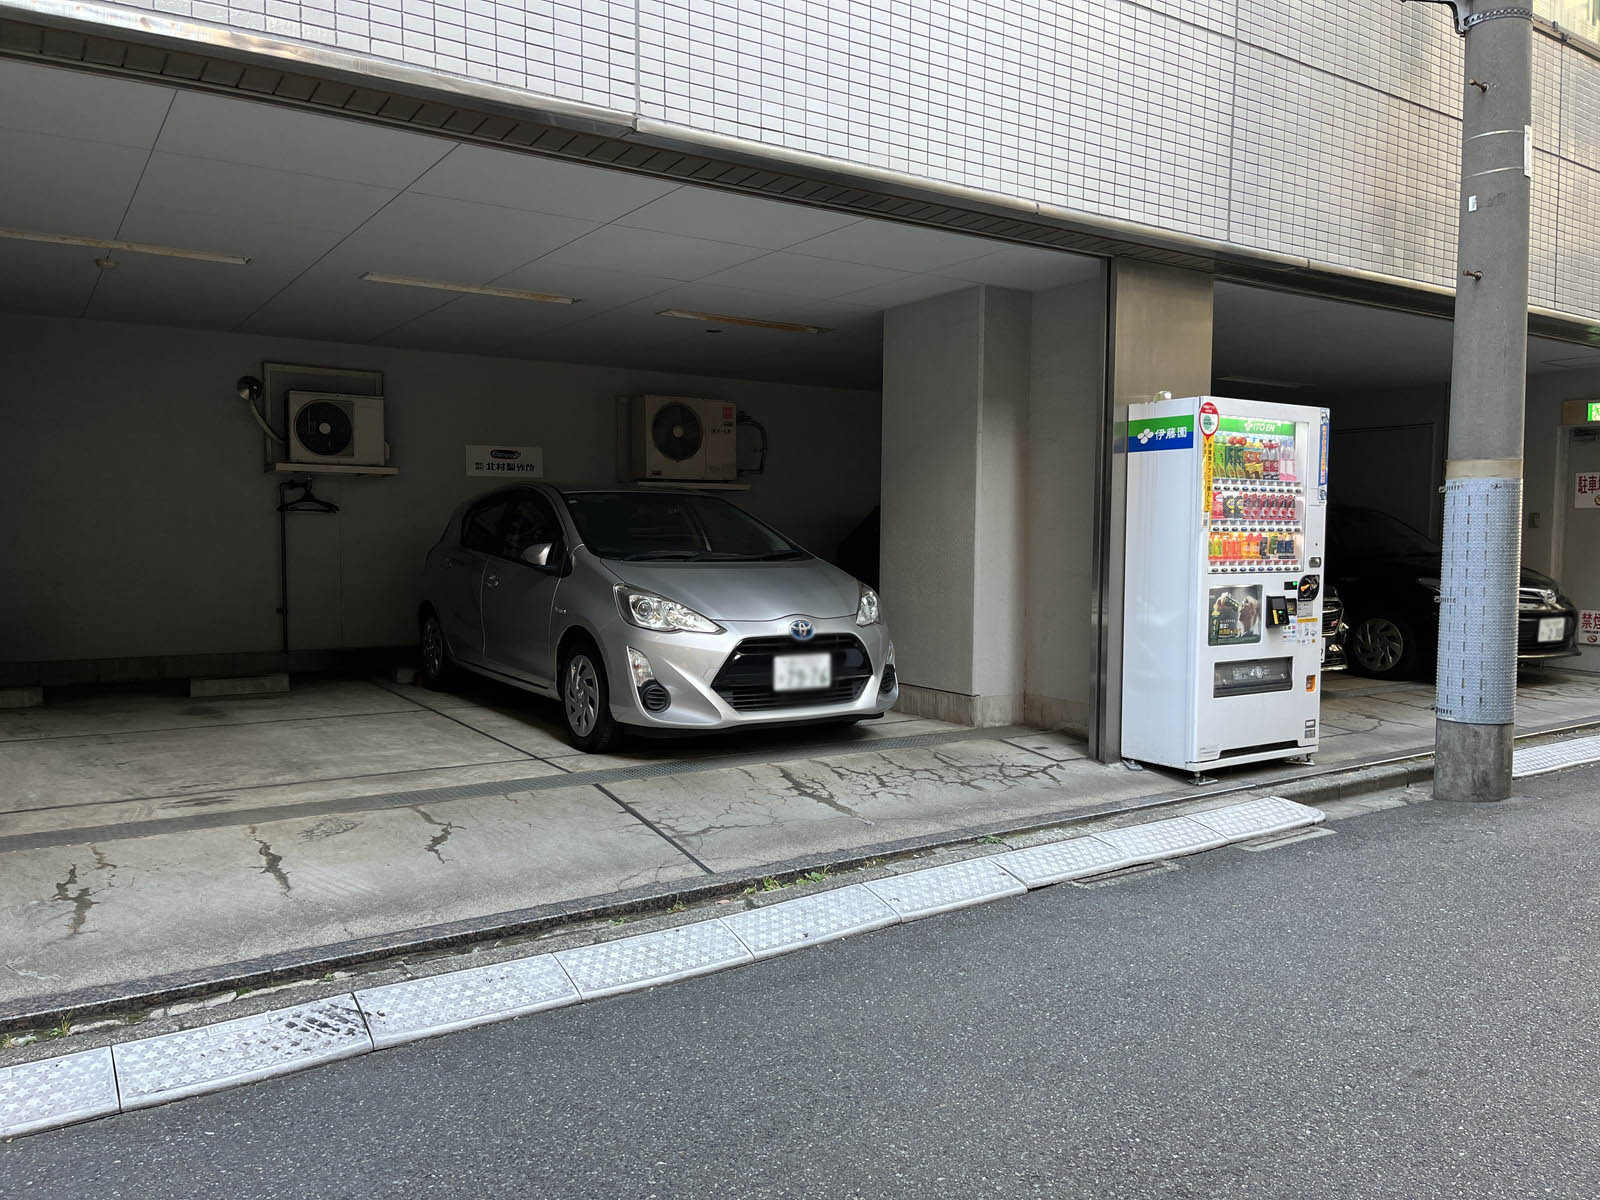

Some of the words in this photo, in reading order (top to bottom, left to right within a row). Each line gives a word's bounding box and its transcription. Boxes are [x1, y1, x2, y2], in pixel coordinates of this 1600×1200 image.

[1155, 426, 1187, 441] 伊藤園
[1577, 475, 1600, 494] 駐車
